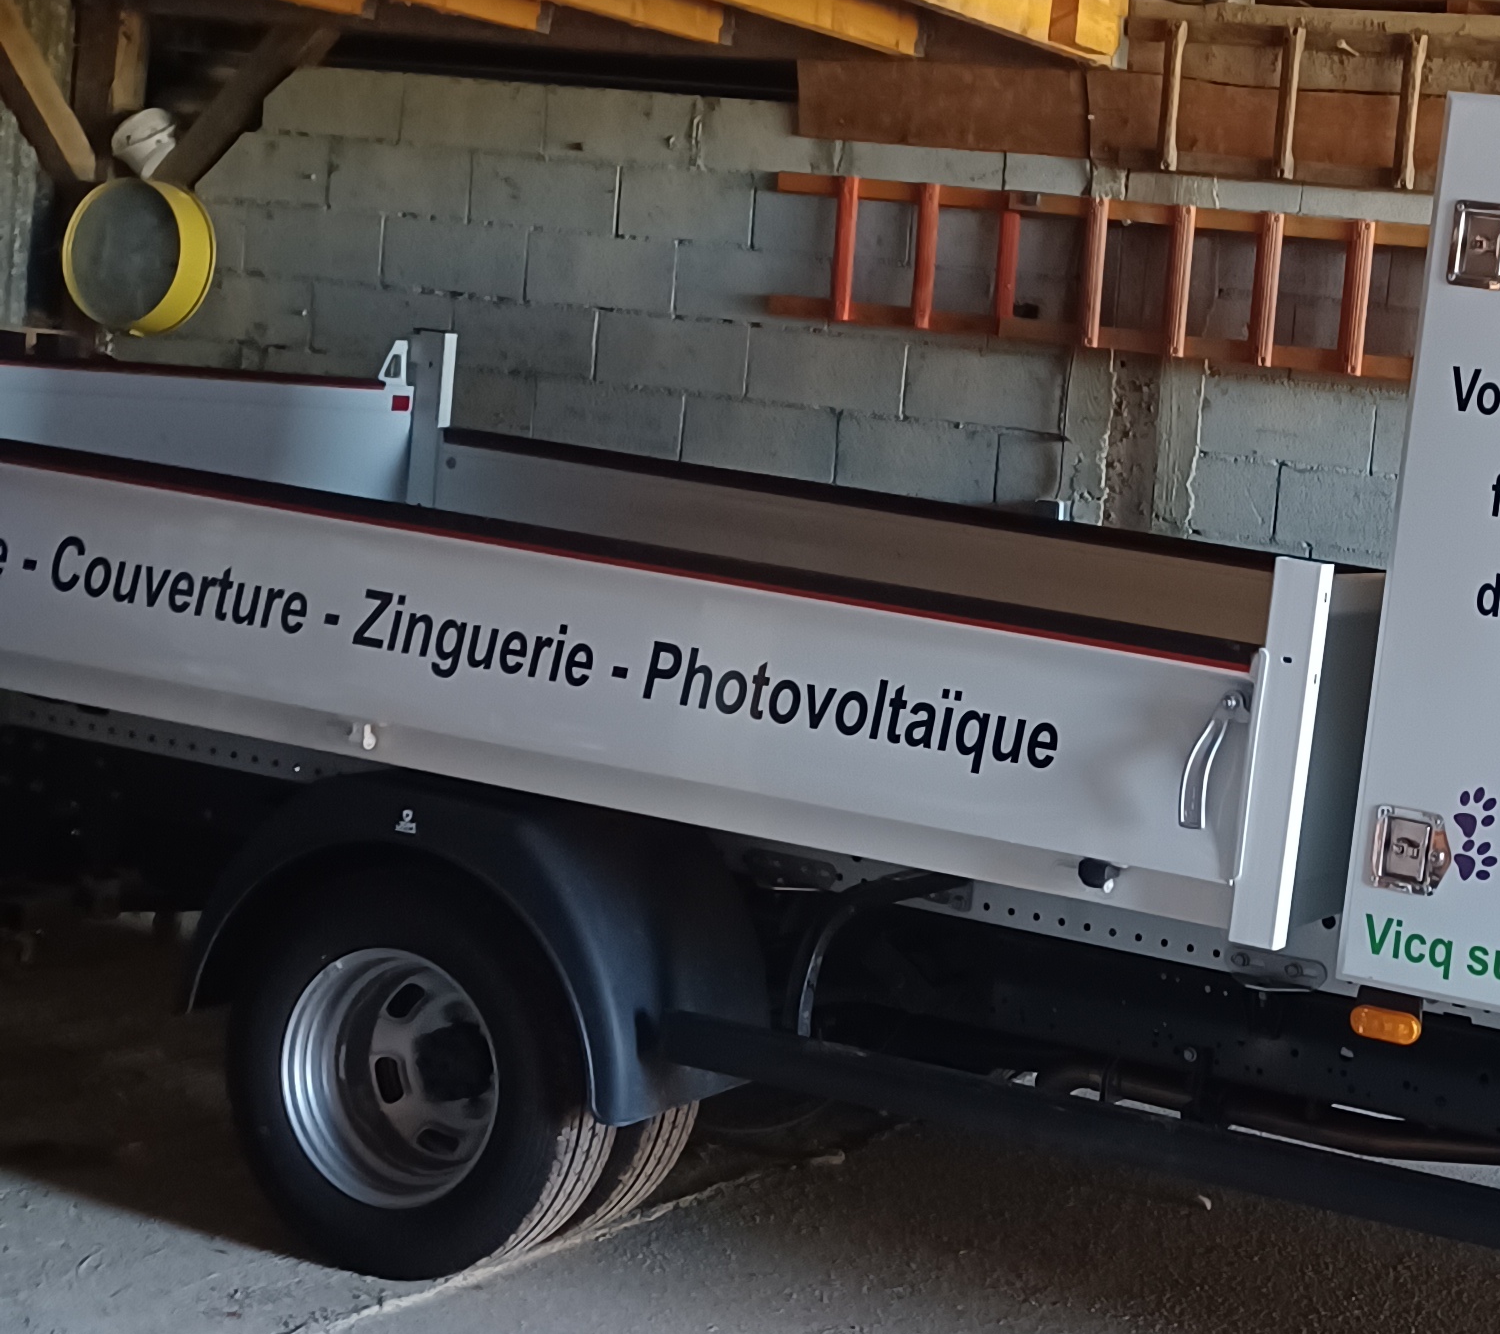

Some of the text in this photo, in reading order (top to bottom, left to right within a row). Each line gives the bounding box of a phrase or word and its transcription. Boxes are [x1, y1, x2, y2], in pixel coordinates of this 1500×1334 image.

[51, 535, 308, 635] Couverture
[352, 588, 594, 687] Zinguerie
[642, 640, 1059, 775] Photovoltaïque
[1365, 913, 1454, 981] Vicq
